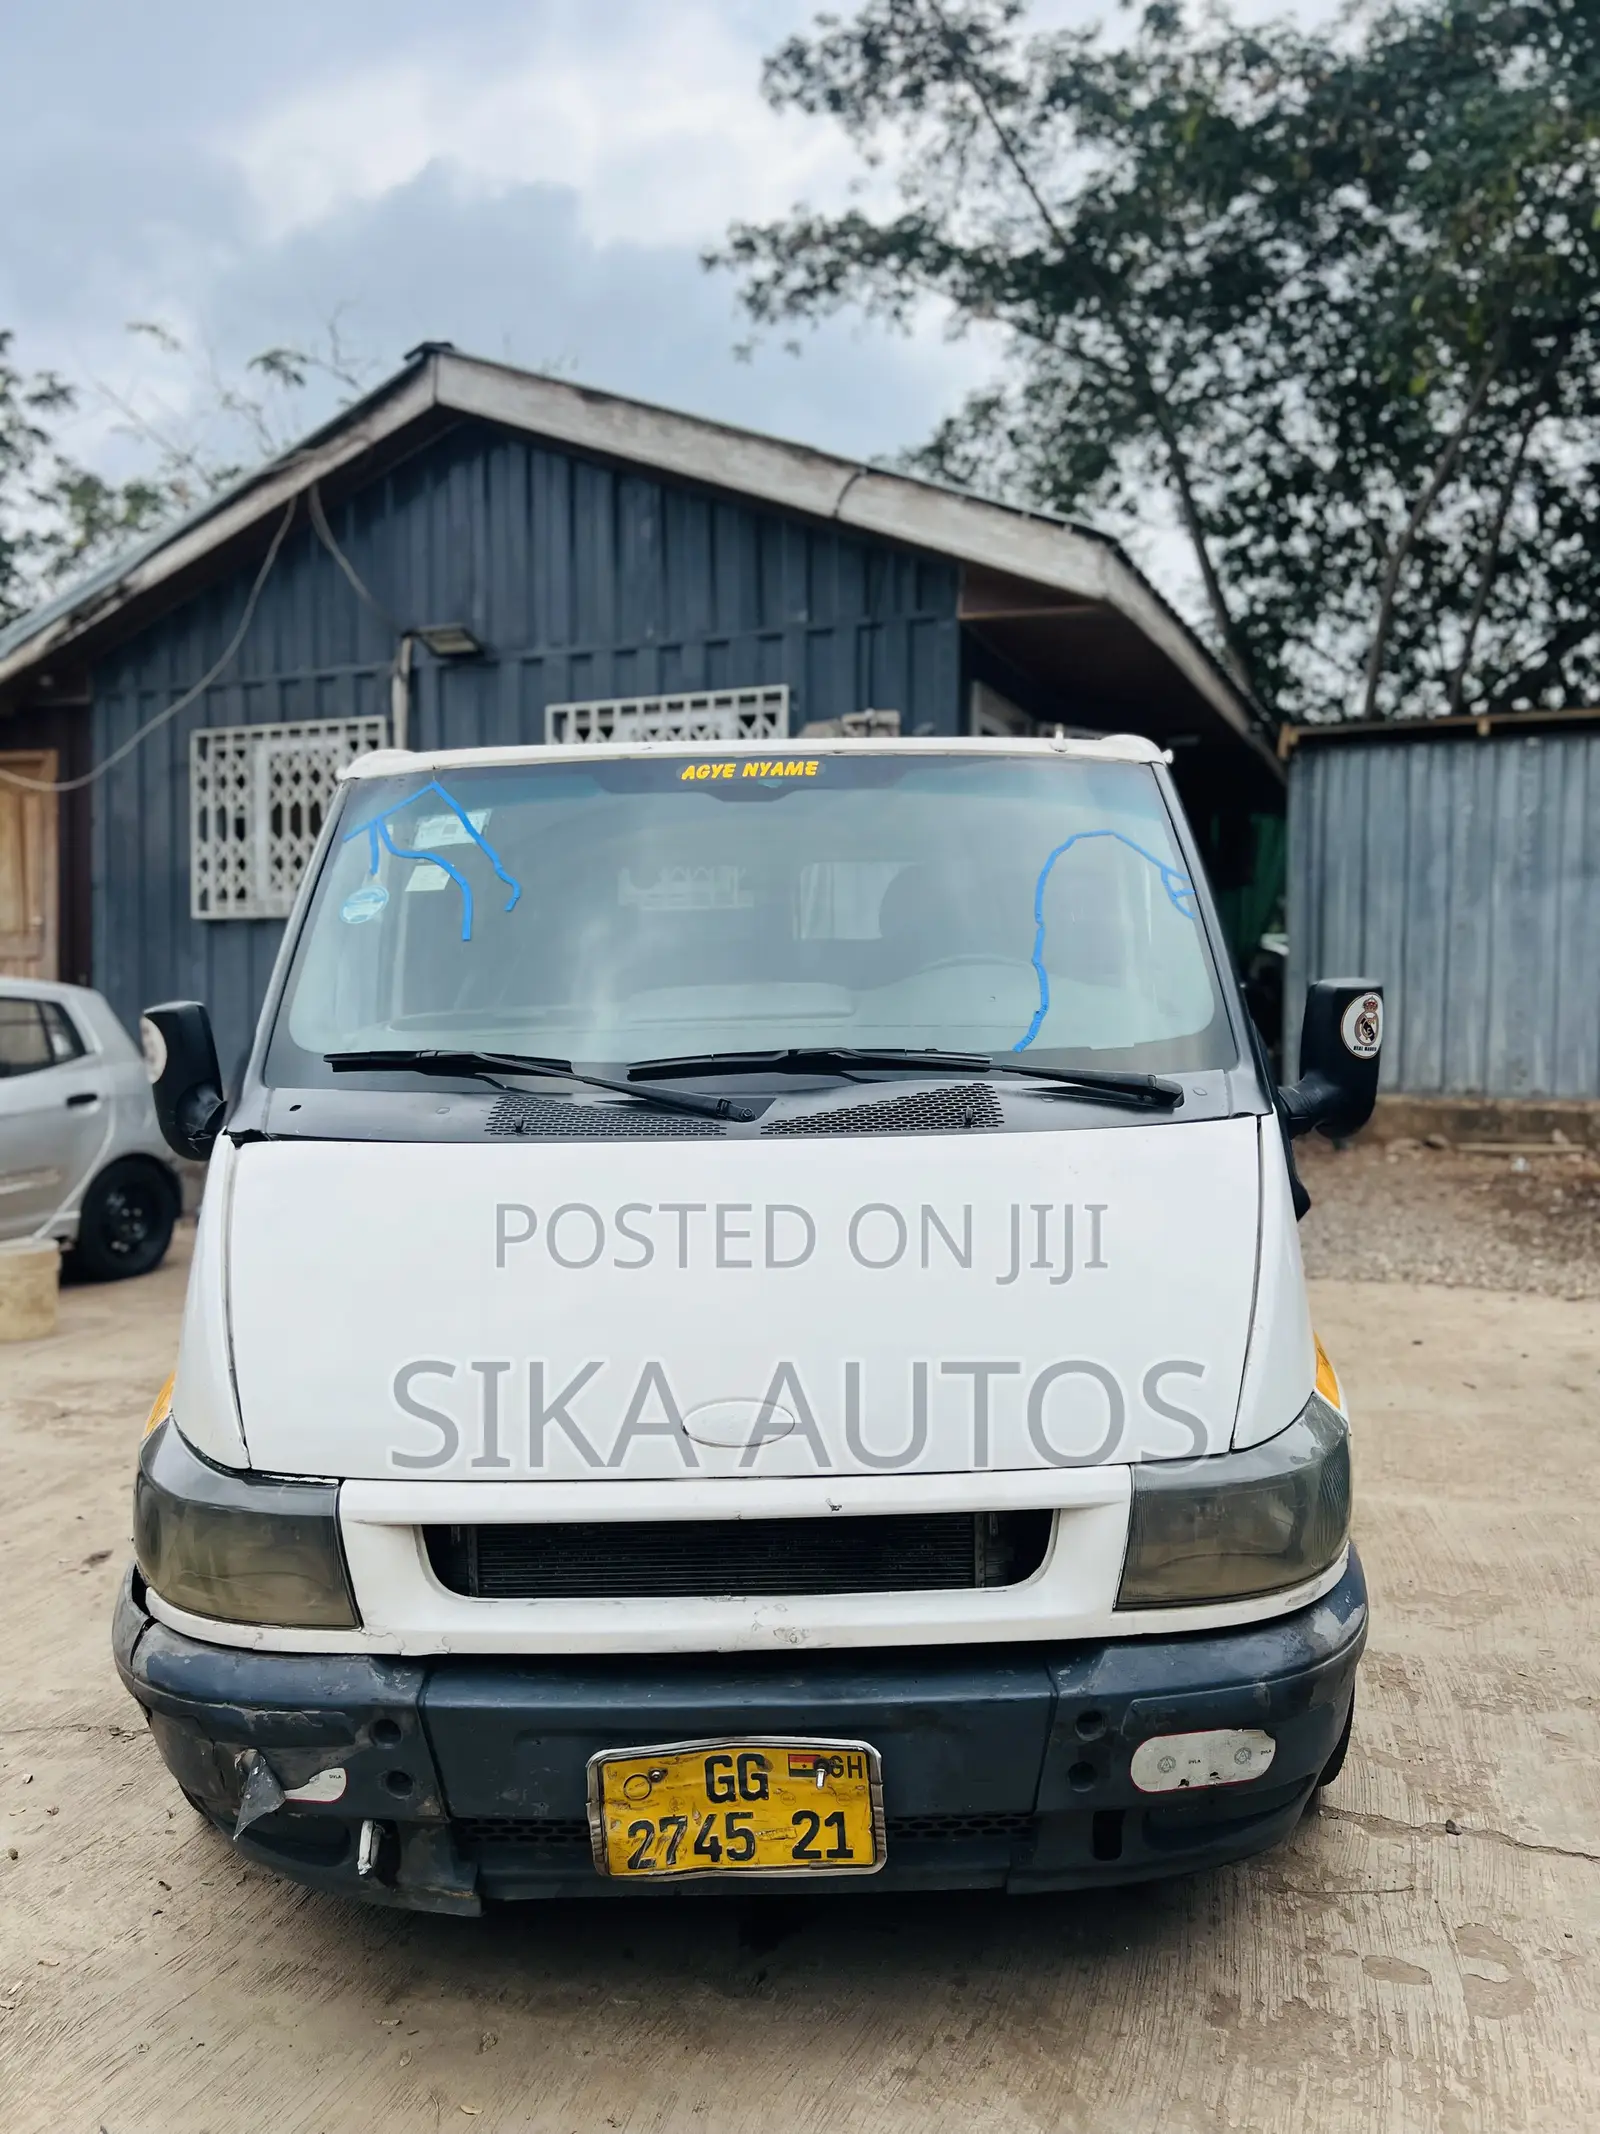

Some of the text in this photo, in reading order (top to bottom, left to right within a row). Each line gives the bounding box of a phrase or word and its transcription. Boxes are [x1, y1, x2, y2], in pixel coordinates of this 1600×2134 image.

[681, 761, 819, 780] AGYE NYAME
[704, 1753, 770, 1804] GG
[829, 1754, 863, 1779] GH
[627, 1810, 854, 1870] 2745 21
